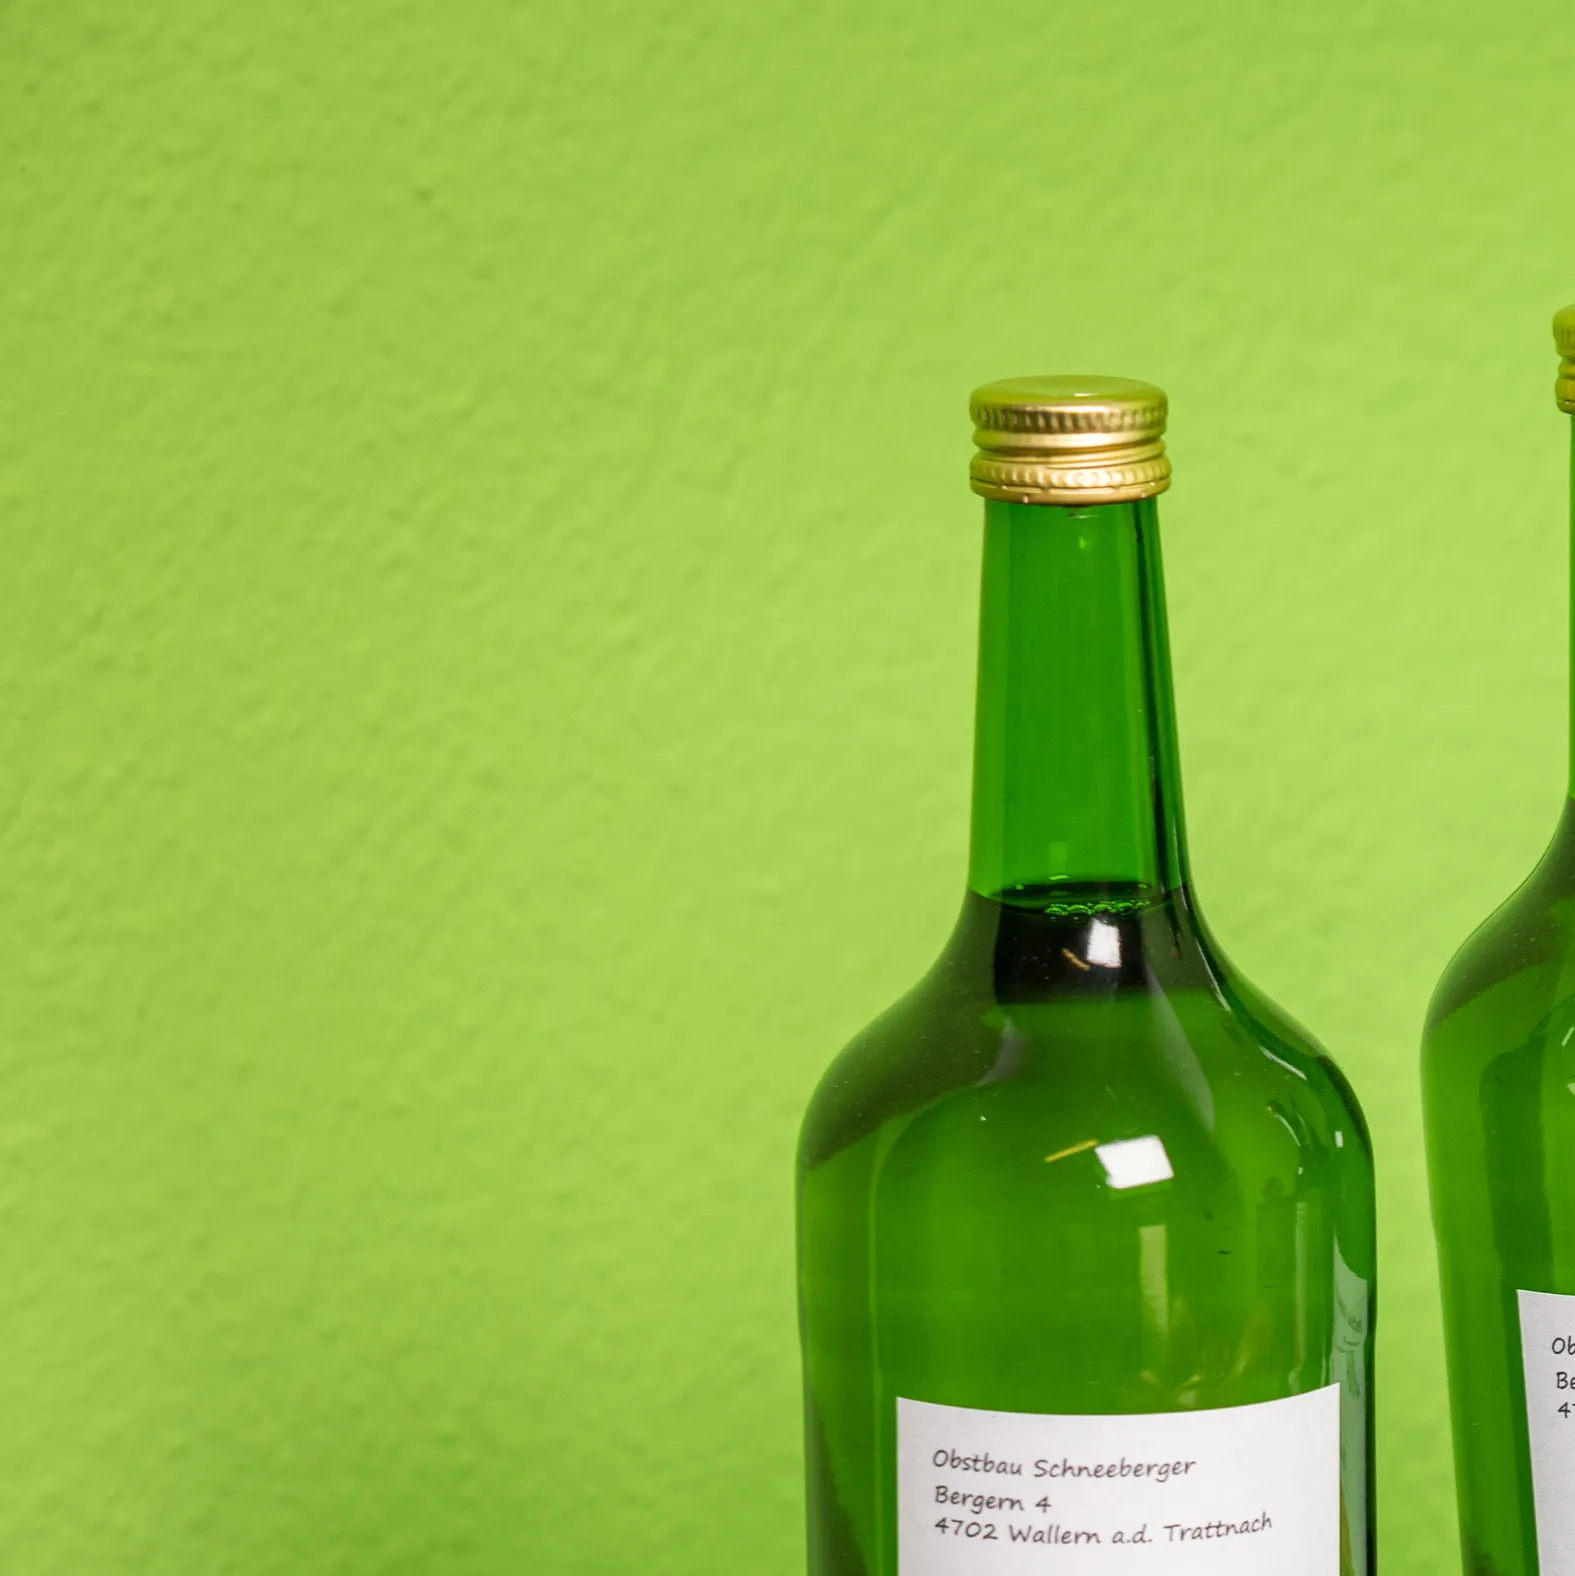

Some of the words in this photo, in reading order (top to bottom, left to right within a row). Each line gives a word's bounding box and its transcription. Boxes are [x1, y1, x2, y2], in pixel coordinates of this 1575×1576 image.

[932, 1448, 1022, 1476] Obstbau
[1034, 1457, 1197, 1483] Schneeberger
[934, 1484, 1025, 1516] Bergern
[1034, 1496, 1052, 1514] 4
[934, 1516, 999, 1541] 4702
[1008, 1524, 1101, 1545] Wallern
[1111, 1523, 1152, 1544] a.d.
[1163, 1511, 1273, 1542] Trattnach
